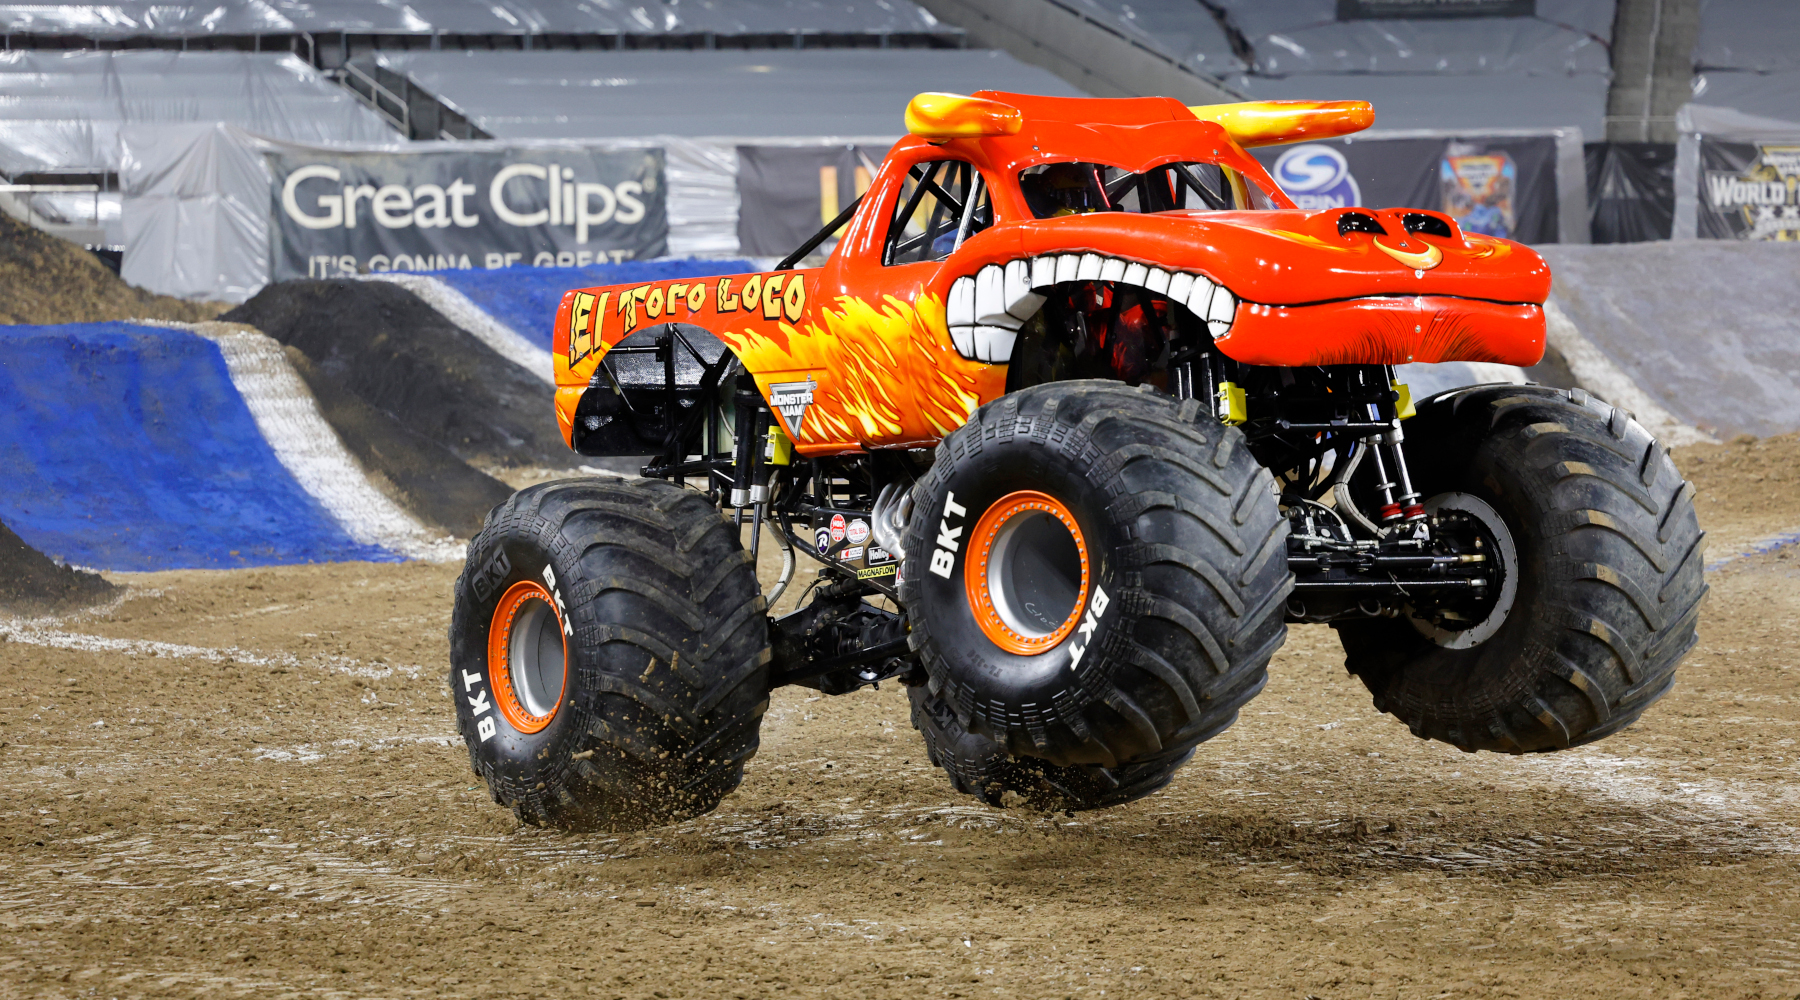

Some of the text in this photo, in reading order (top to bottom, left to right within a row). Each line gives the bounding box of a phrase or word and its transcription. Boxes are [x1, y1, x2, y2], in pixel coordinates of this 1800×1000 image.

[282, 163, 646, 244] Great Clips
[308, 255, 357, 279] IT'S
[368, 253, 472, 272] GONNA
[769, 392, 813, 407] MONSTER
[783, 404, 803, 417] JAM
[869, 548, 890, 560] Holley
[929, 490, 967, 580] BKT
[472, 545, 511, 603] BKT
[858, 565, 895, 578] MAGNAFLOW
[542, 563, 574, 637] BKT
[1068, 584, 1111, 671] BKT
[462, 668, 497, 742] BKT
[924, 697, 963, 738] BKT
